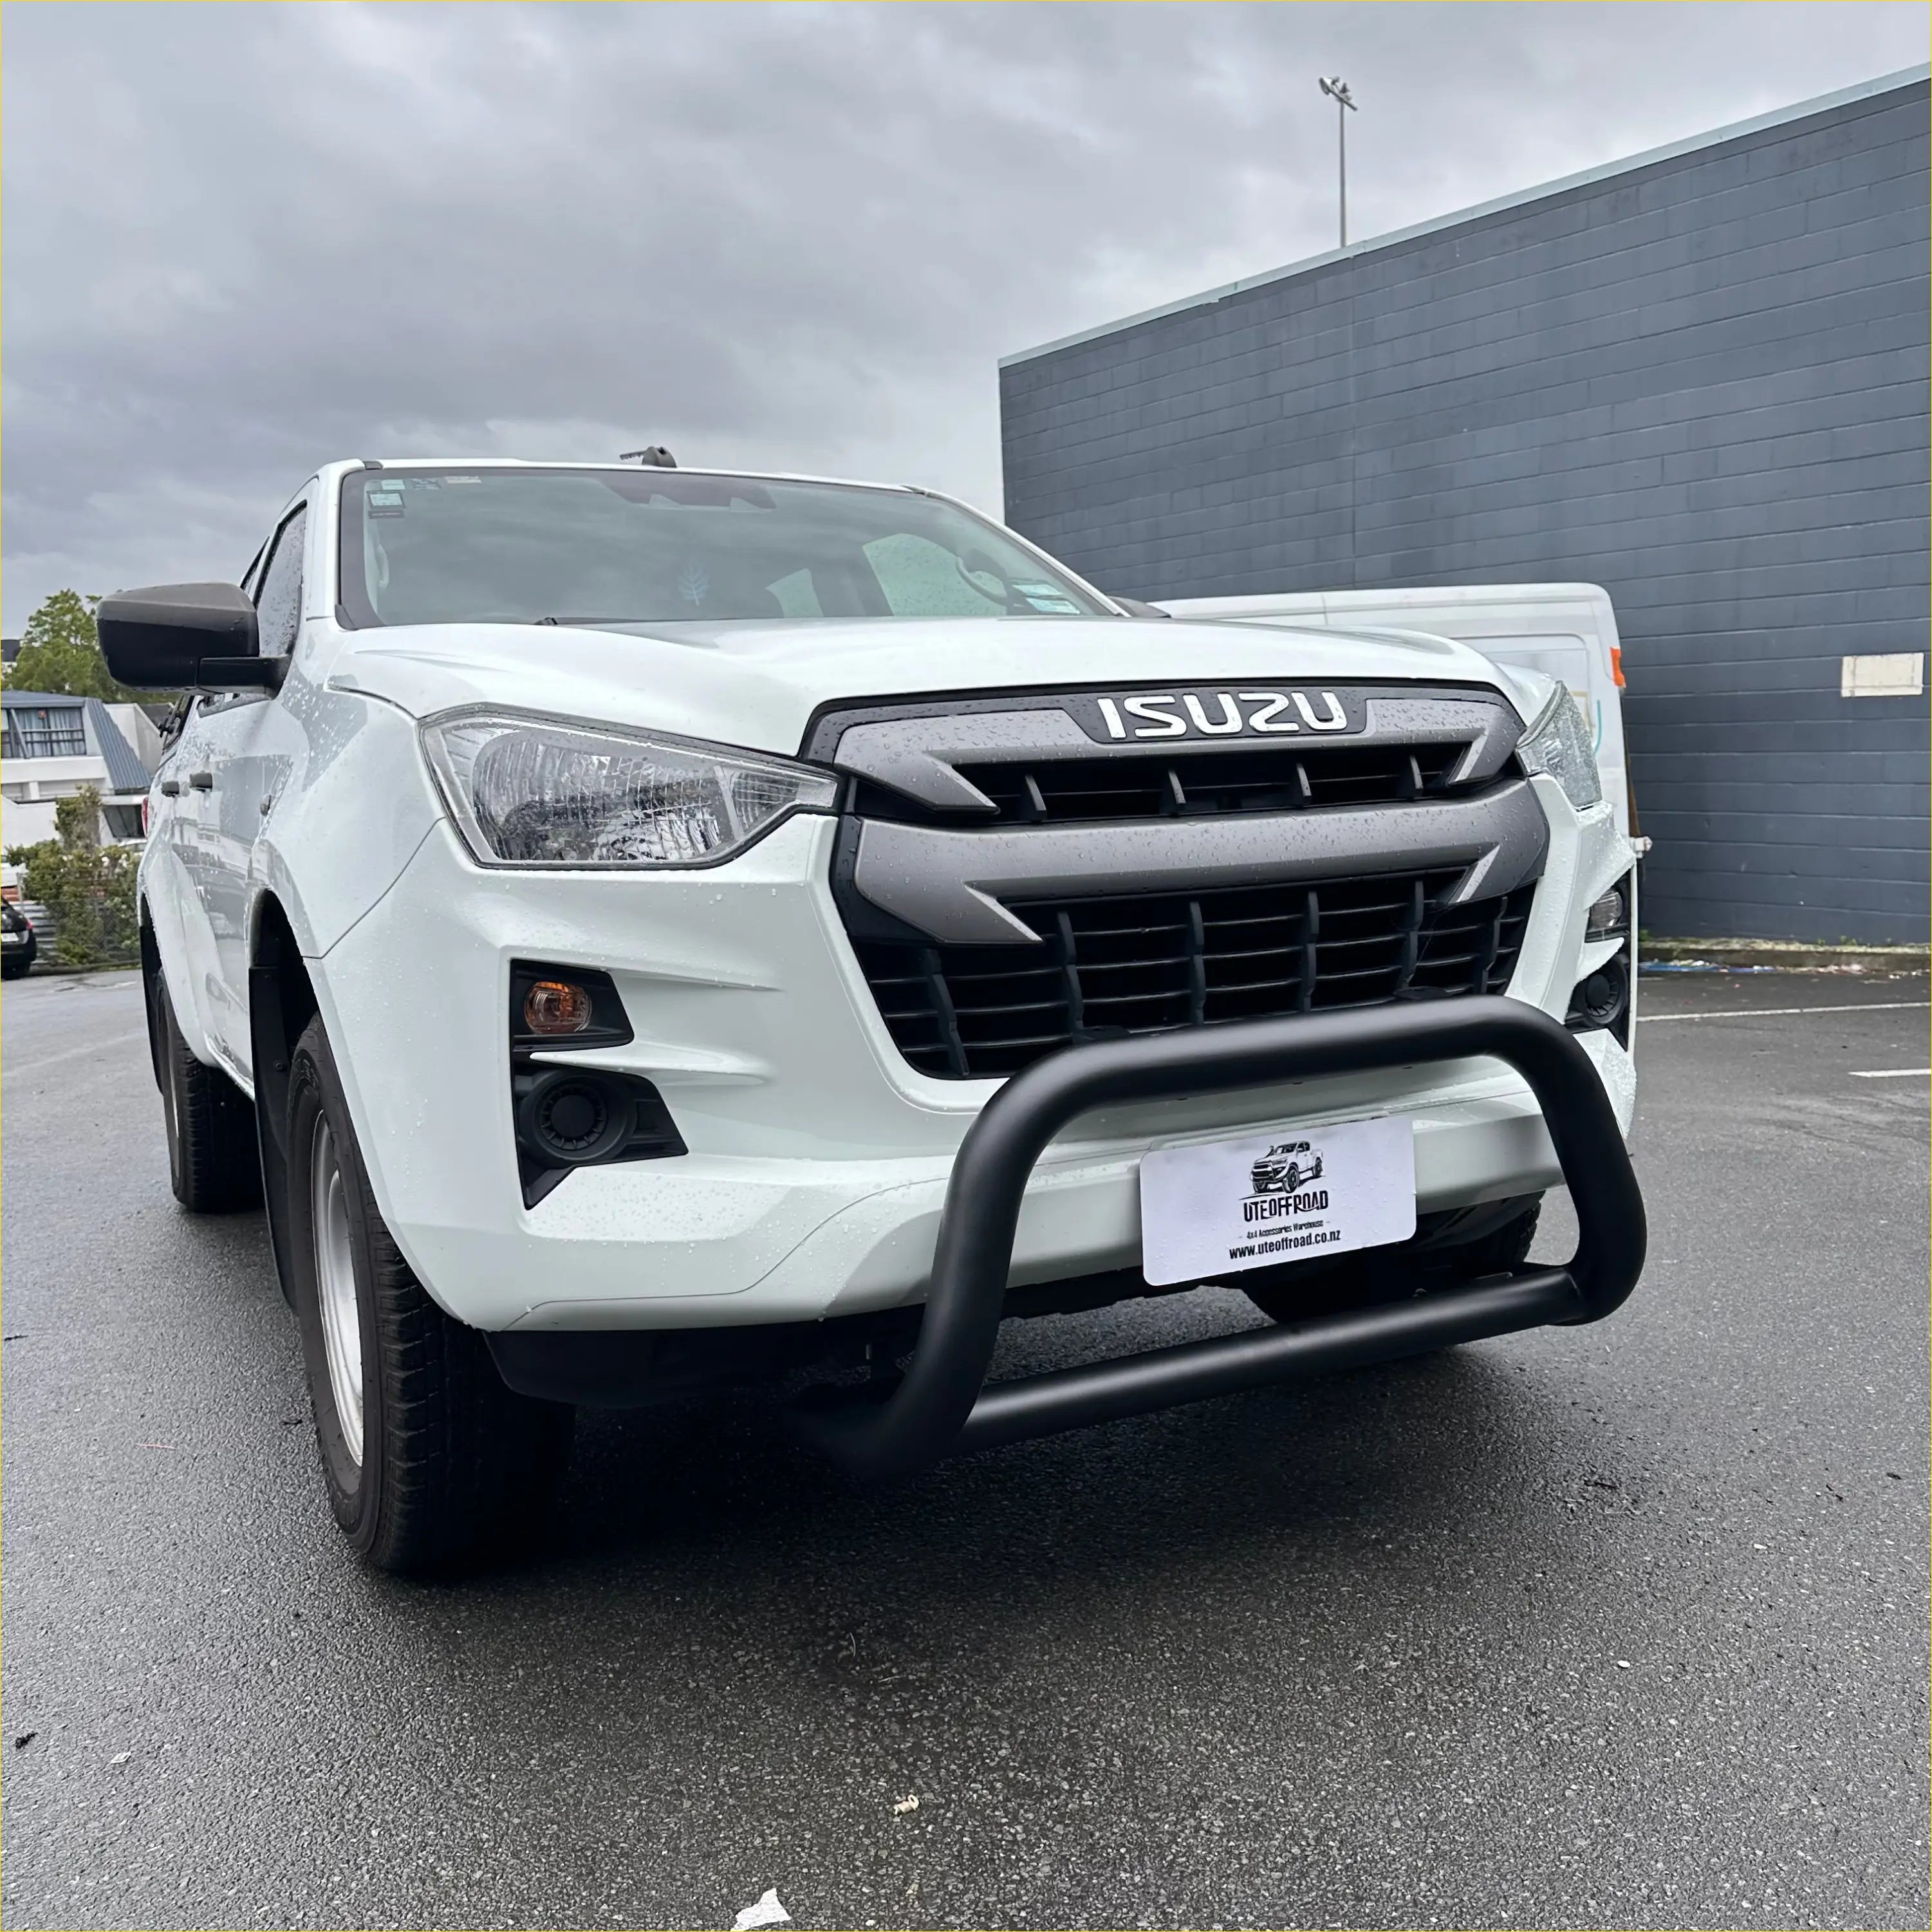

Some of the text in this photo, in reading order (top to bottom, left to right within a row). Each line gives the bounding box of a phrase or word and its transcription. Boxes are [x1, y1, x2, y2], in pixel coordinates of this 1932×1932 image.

[1097, 691, 1348, 740] ISUZU
[1229, 1230, 1341, 1259] www.uteoffroad.co.nz
[1247, 1220, 1324, 1240] 4x4 Accessories Warehouse
